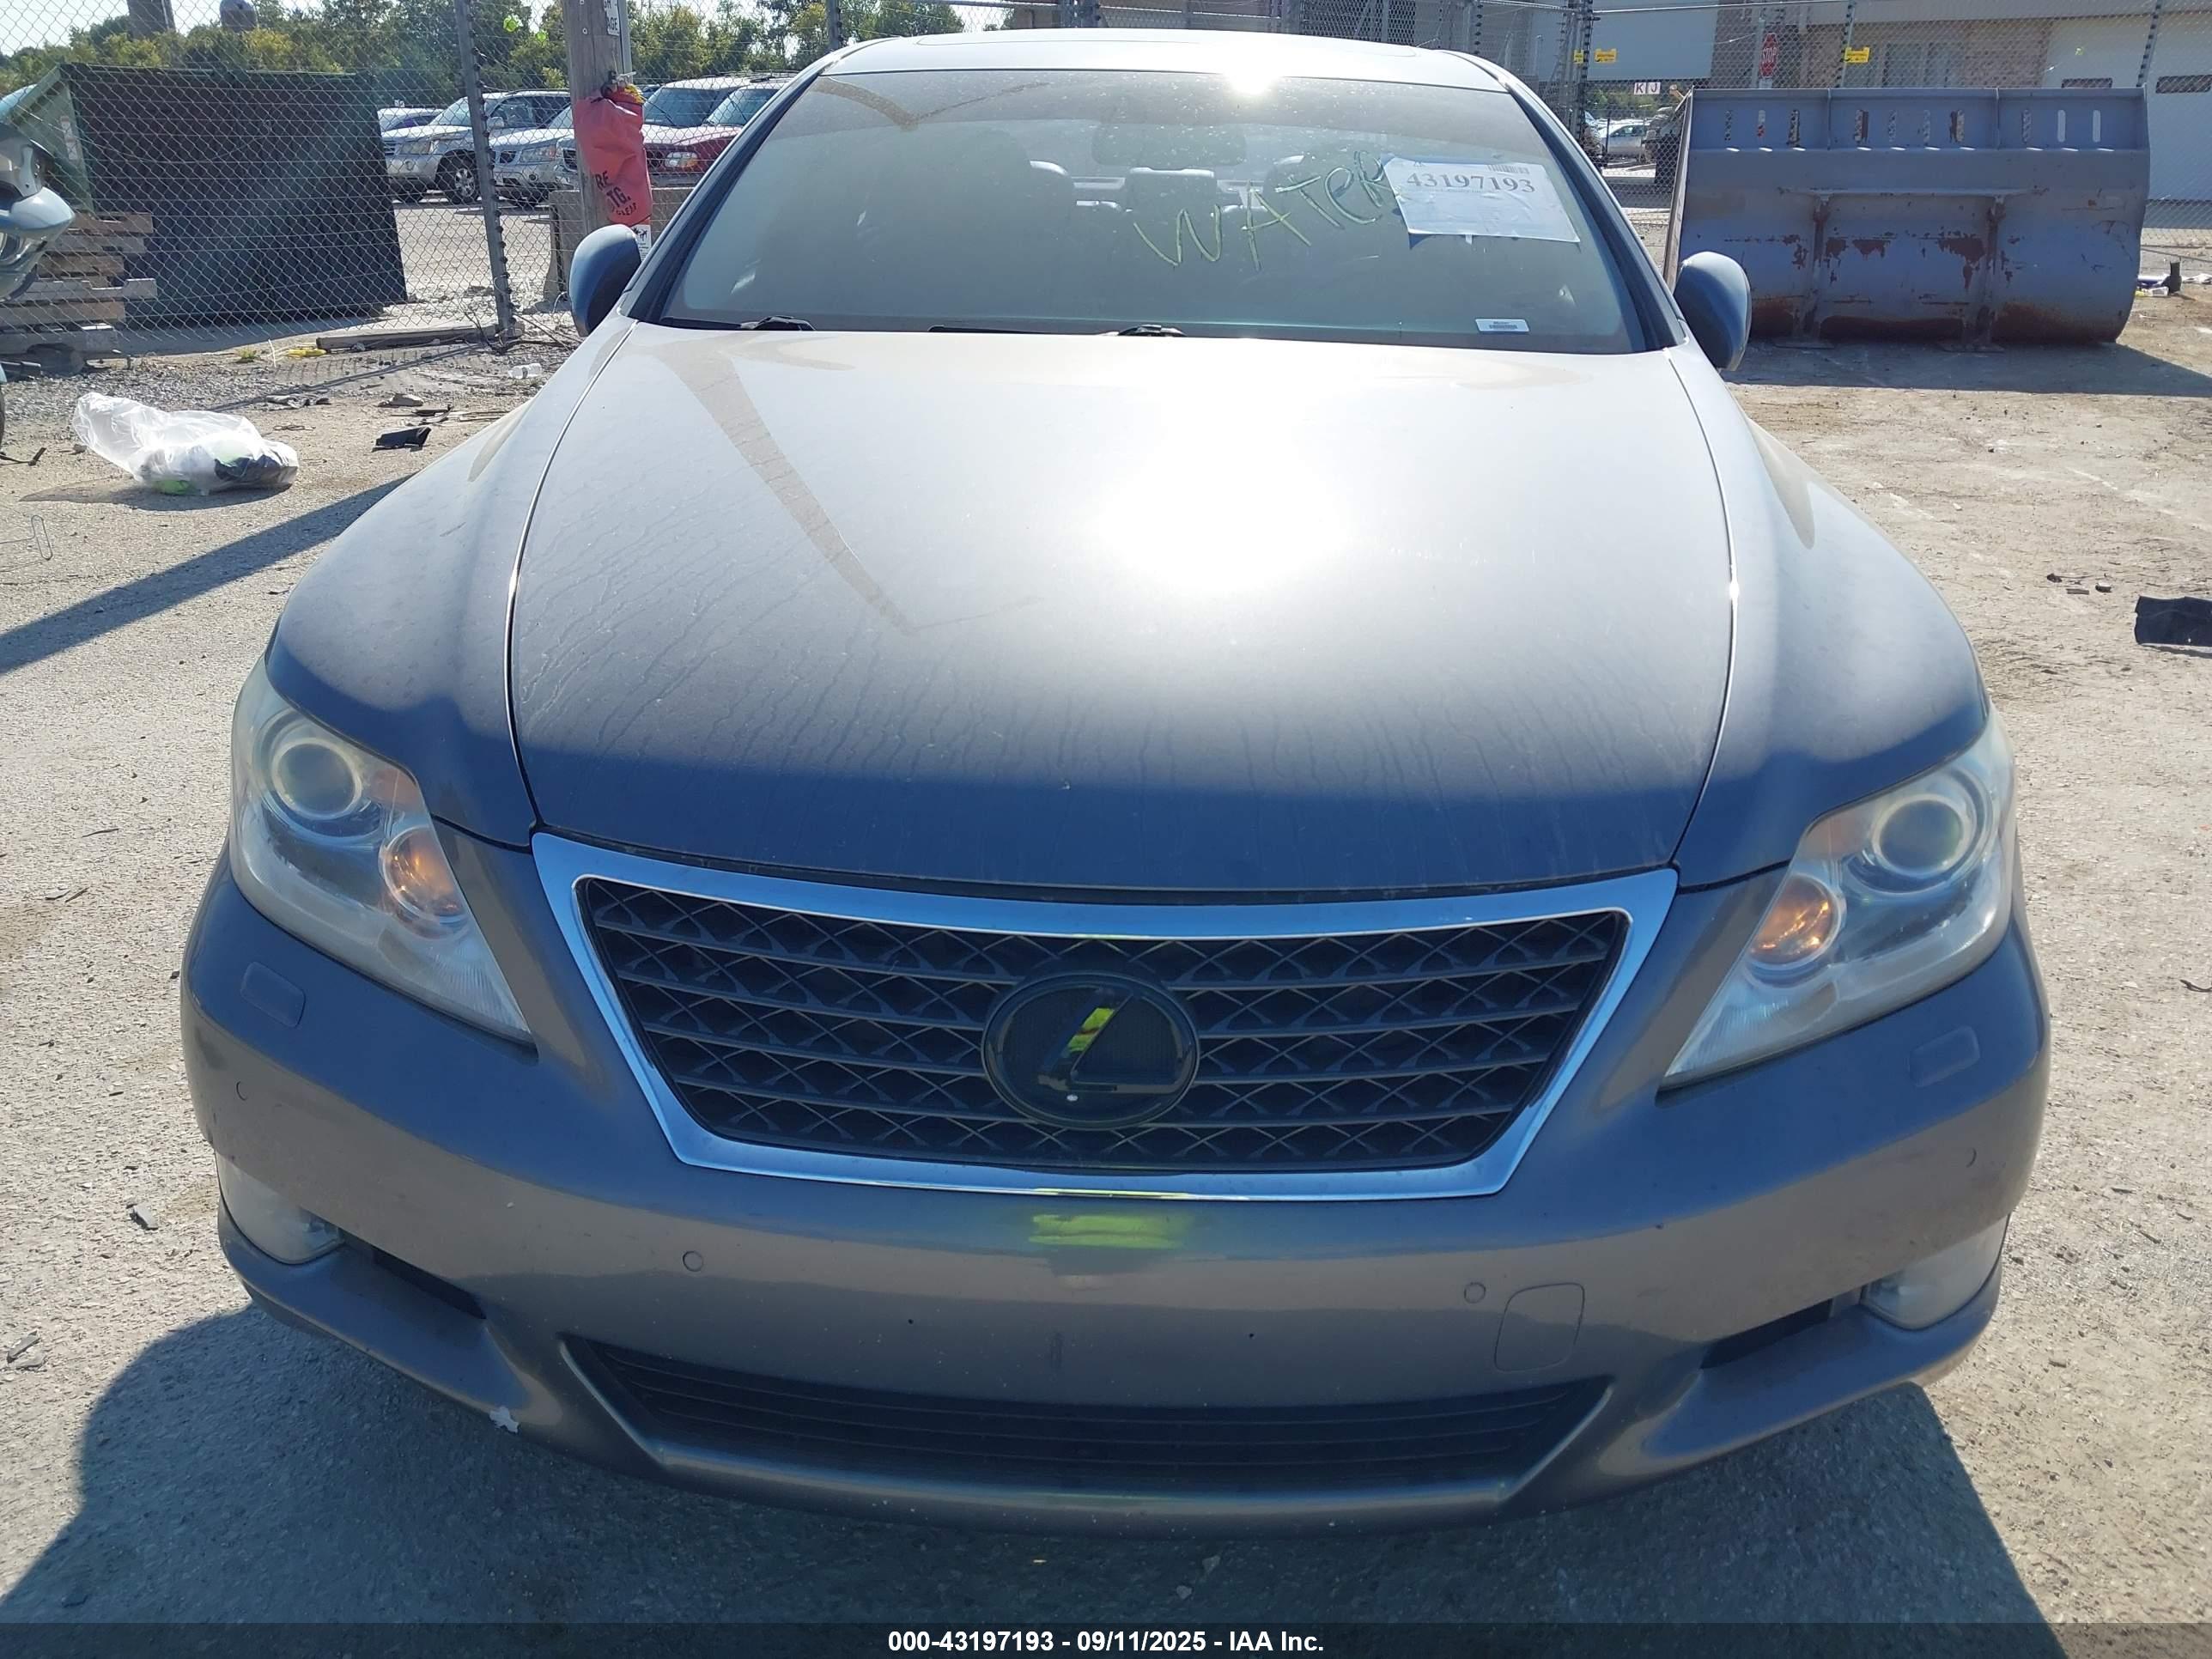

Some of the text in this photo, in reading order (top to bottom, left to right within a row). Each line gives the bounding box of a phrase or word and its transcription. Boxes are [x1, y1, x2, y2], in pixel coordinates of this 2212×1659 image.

[1762, 46, 1778, 64] STOP
[1636, 83, 1657, 94] K J
[1407, 173, 1536, 194] 43197193
